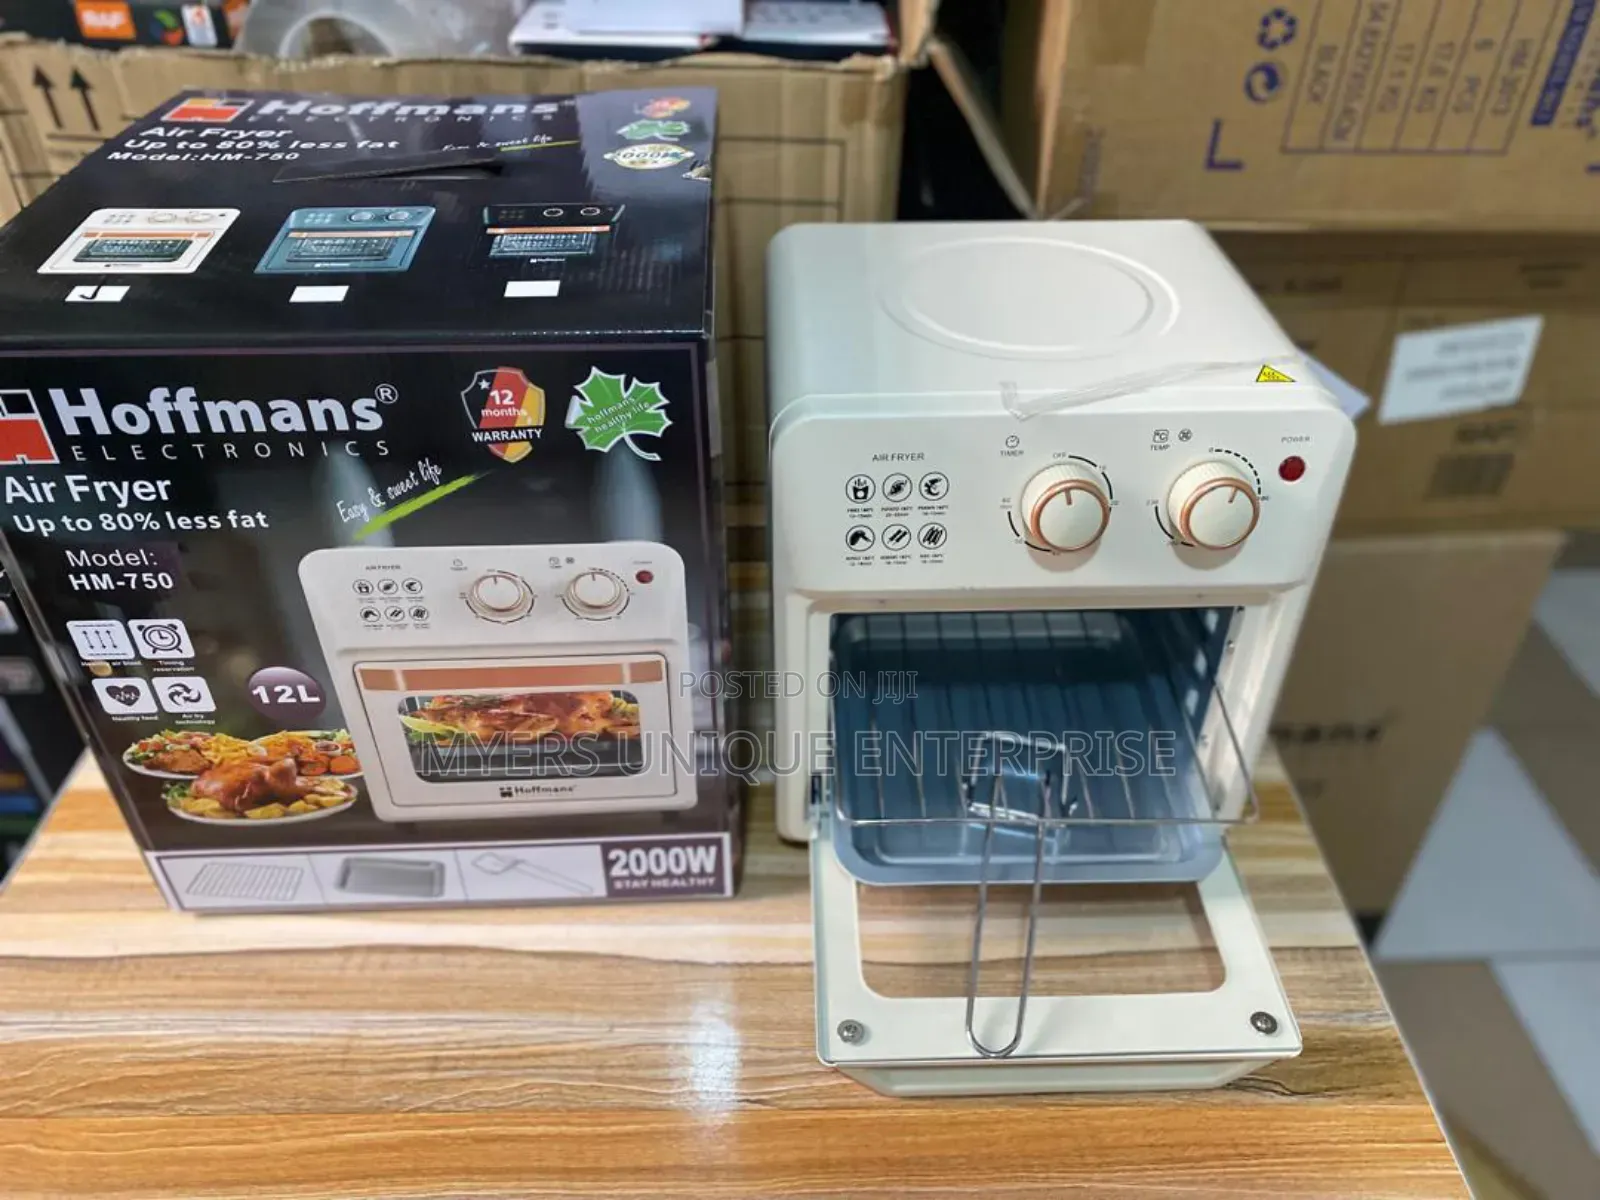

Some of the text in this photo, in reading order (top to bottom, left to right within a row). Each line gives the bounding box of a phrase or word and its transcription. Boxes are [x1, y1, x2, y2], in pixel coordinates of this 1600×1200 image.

[139, 126, 293, 140] Air Fryer
[124, 139, 400, 151] Up to 80% less fat
[489, 389, 515, 406] 12
[480, 407, 528, 418] months
[471, 428, 542, 443] WARRANTY
[71, 440, 390, 462] ELECTRONICS
[872, 451, 926, 463] AIR FRYER
[4, 473, 172, 508] Air Fryer
[335, 457, 442, 523] Easy & sweet life
[13, 509, 270, 537] Up to 80% less fat
[65, 547, 158, 568] Model:
[68, 571, 174, 592] HM-750
[252, 684, 321, 705] 12L
[607, 844, 718, 878] 2000W
[613, 876, 717, 890] STAY HEALTHY
